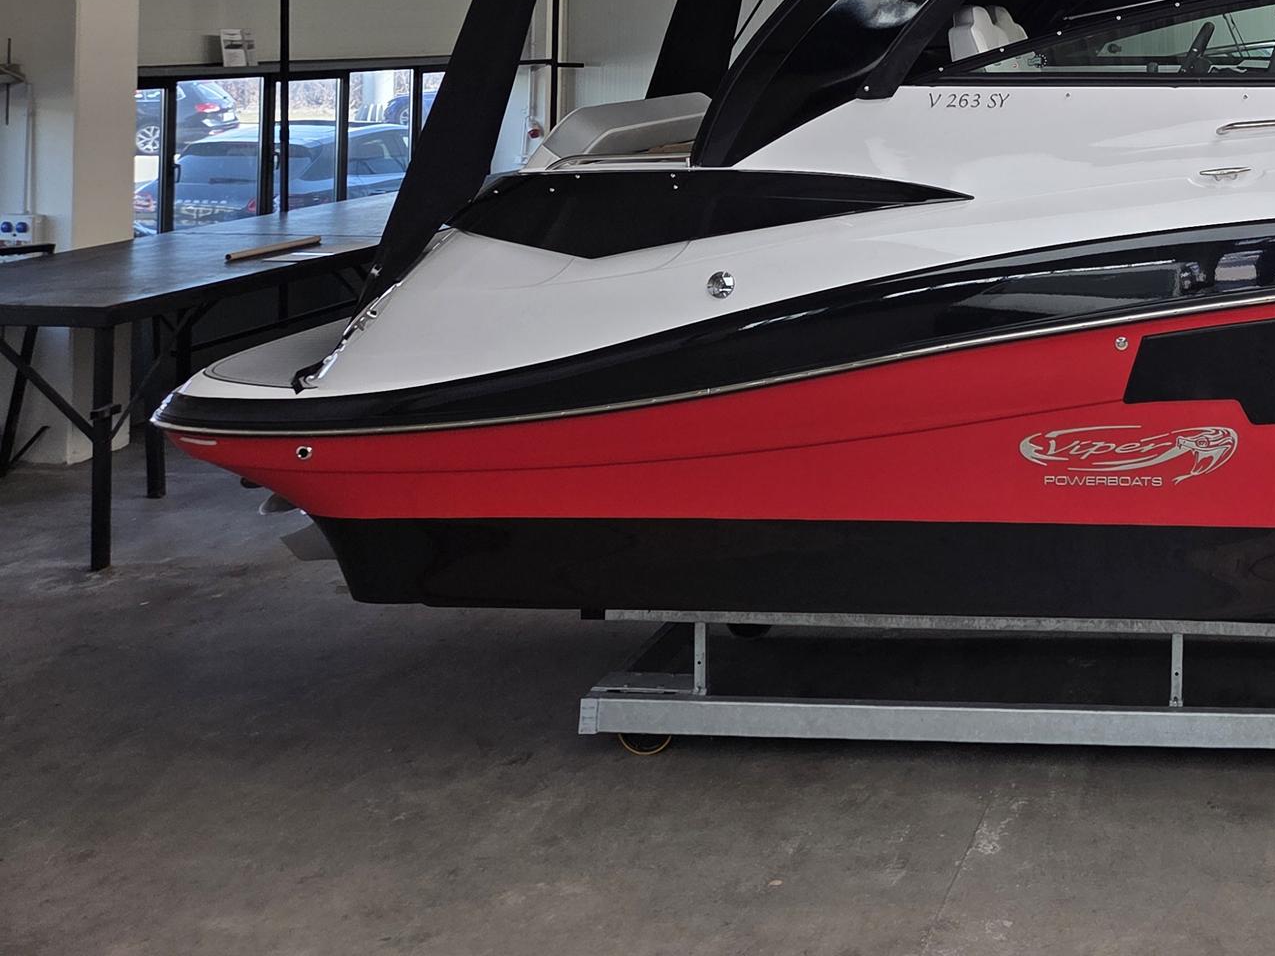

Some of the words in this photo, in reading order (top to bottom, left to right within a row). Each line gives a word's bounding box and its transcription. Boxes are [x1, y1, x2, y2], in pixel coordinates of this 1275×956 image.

[928, 92, 942, 108] V
[945, 92, 981, 108] 263
[986, 92, 1010, 108] SY
[1047, 439, 1172, 460] Viper
[1043, 475, 1163, 487] POWERBOATS
